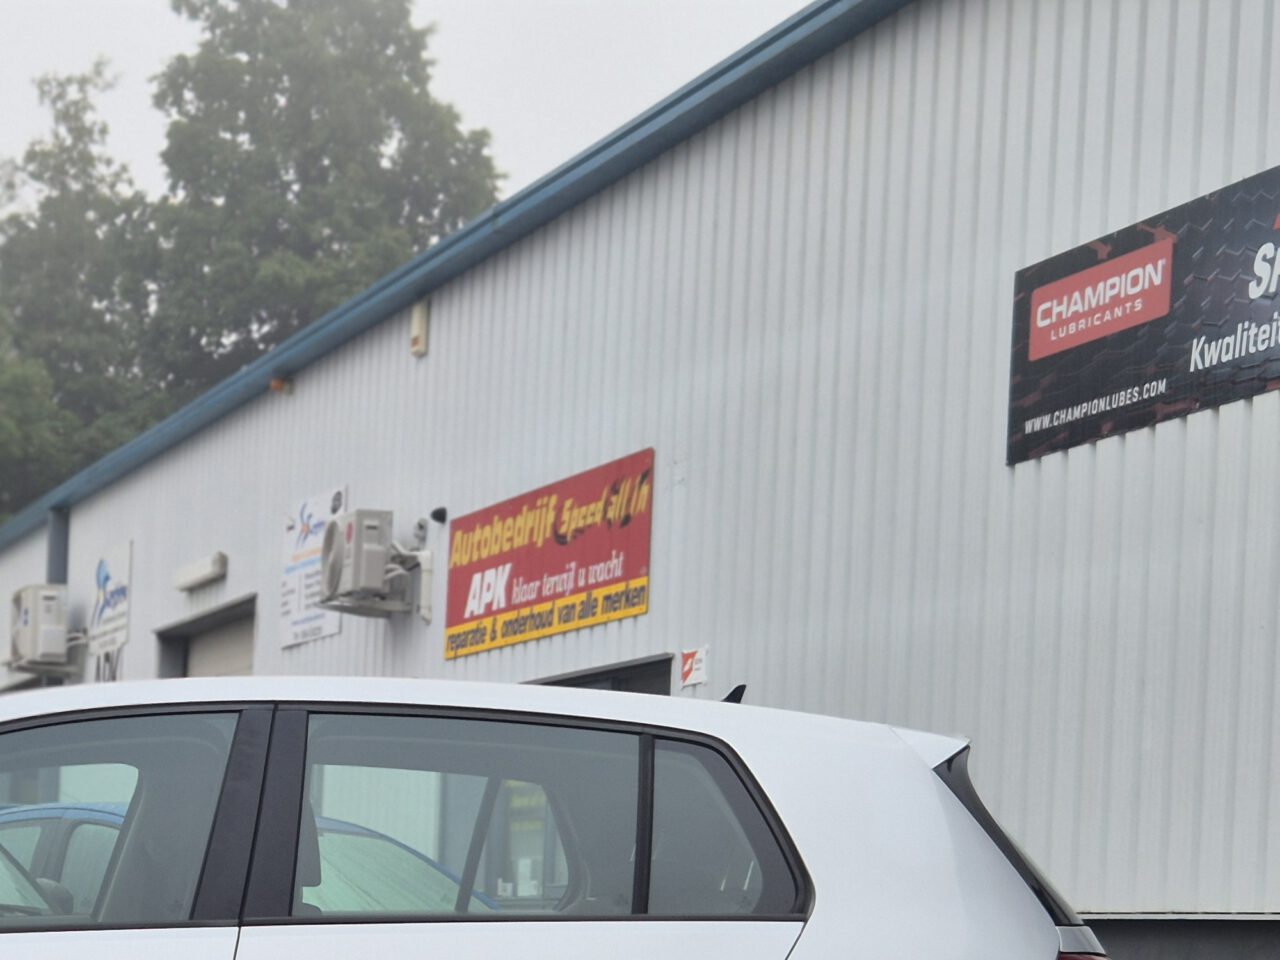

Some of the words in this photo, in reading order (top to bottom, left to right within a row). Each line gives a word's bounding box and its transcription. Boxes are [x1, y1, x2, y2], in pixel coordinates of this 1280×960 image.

[1036, 259, 1165, 328] CHAMPION
[1051, 298, 1143, 341] LUBRICANTS
[1025, 378, 1166, 434] WWW.CHAMPIONLUBES.COM
[450, 494, 558, 569] Autobedrijf
[464, 563, 512, 619] APK
